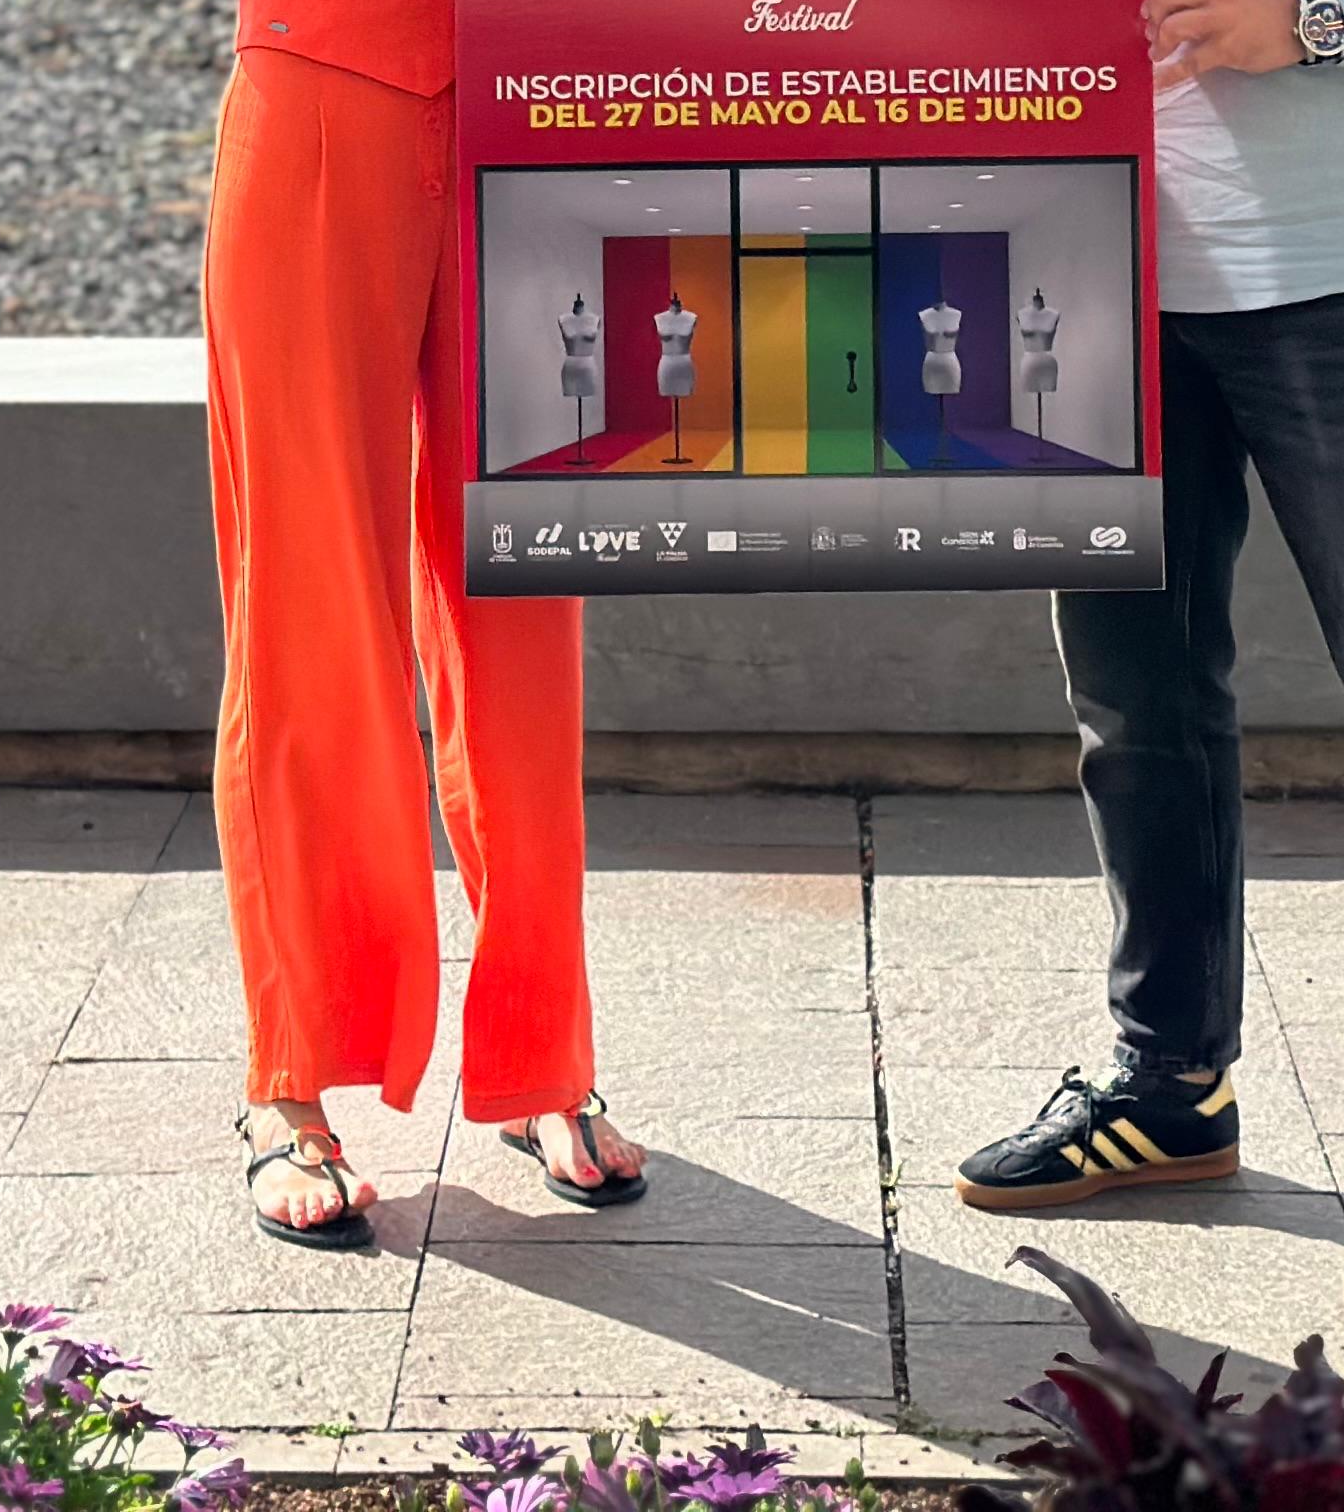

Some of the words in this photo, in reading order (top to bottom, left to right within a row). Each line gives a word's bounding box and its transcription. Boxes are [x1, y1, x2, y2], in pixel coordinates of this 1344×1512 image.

[496, 67, 715, 101] INSCRIPCIÓN
[726, 71, 771, 97] DE
[781, 65, 1117, 96] ESTABLECIMIENTOS
[529, 103, 596, 129] DEL
[603, 102, 644, 128] 27
[654, 101, 700, 127] DE
[710, 99, 812, 126] MAYO
[820, 99, 866, 124] AL
[874, 98, 909, 123] 16
[919, 97, 966, 123] DE
[974, 95, 1083, 122] JUNIO
[527, 546, 572, 556] SODEPAL
